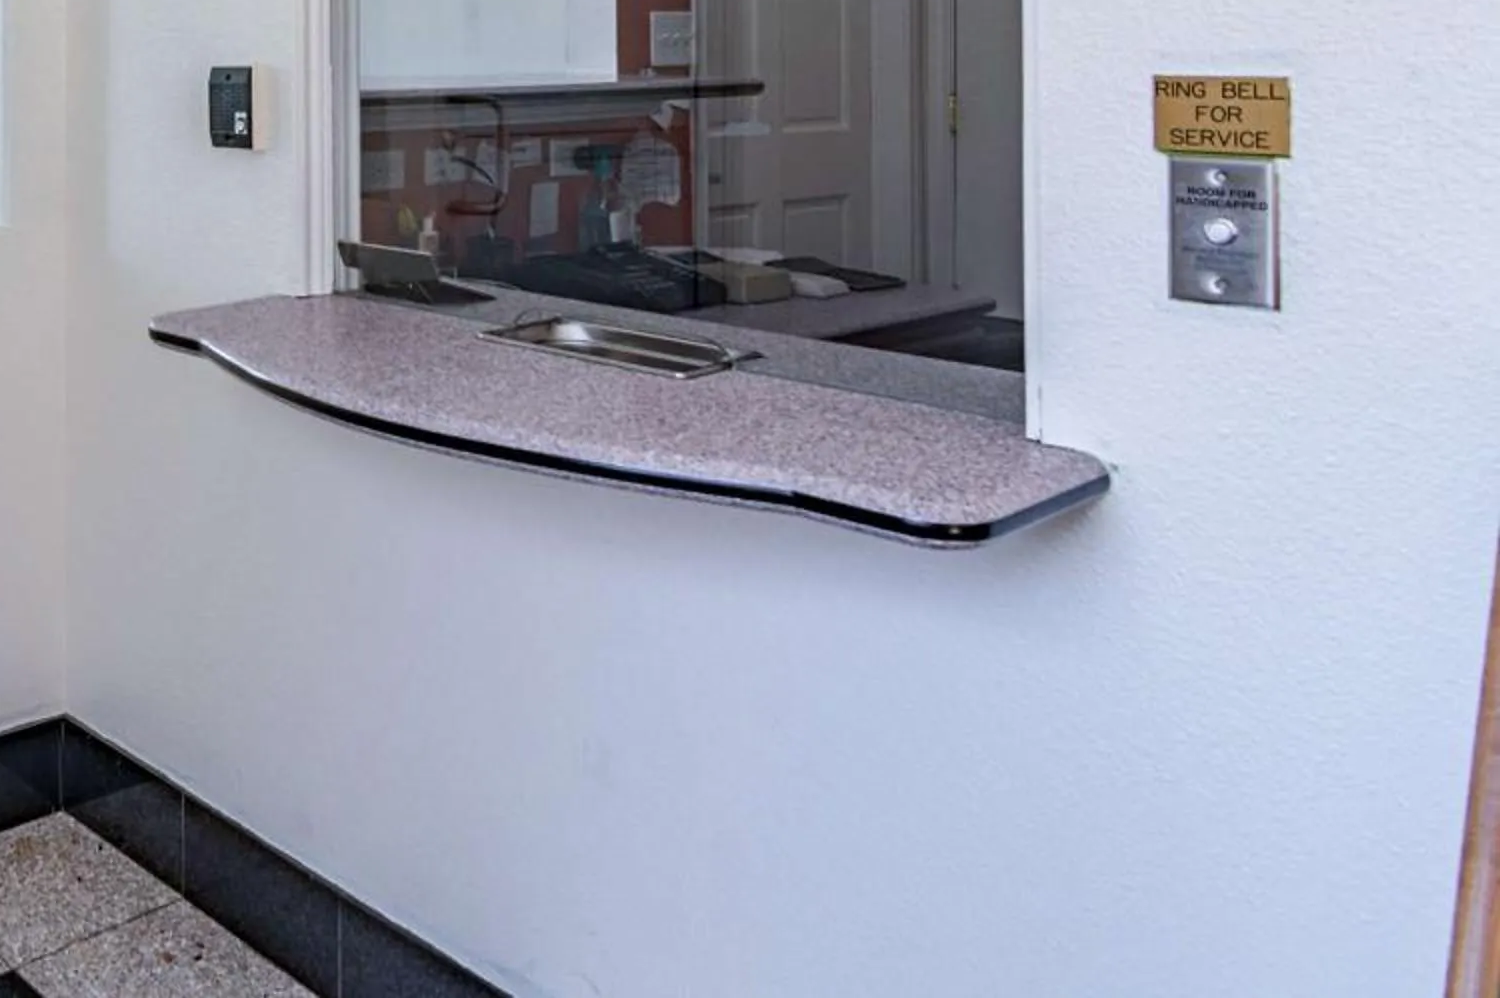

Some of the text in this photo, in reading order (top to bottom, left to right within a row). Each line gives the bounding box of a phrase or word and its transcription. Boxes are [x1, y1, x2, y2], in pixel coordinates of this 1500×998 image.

[1155, 80, 1285, 101] RING BELL
[1195, 105, 1243, 123] FOR
[1169, 128, 1271, 150] SERVICE
